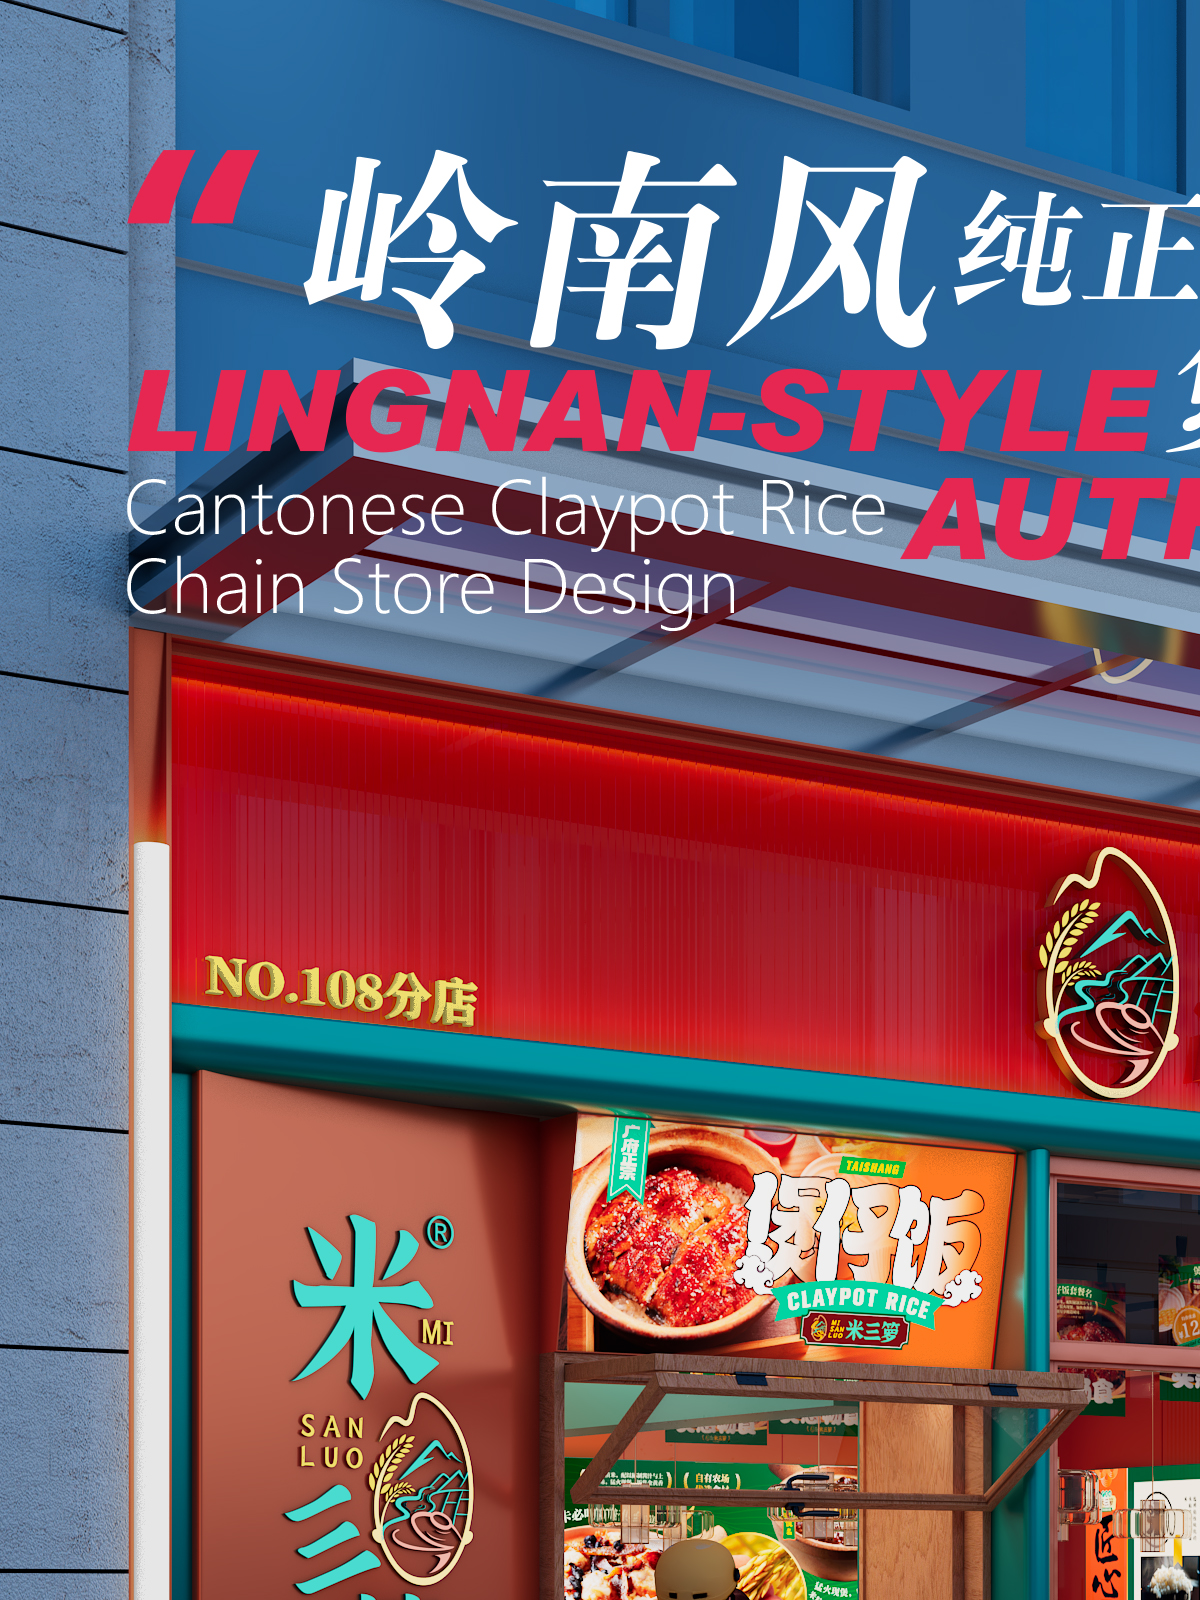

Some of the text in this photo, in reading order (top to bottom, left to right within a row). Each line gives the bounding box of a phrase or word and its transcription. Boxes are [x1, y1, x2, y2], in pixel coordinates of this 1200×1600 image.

[204, 954, 479, 1028] NO.108分店
[846, 1160, 900, 1176] TAISHANG
[745, 1170, 986, 1295] 煲仔饭
[786, 1286, 931, 1320] CLAYPOT RICE
[422, 1318, 455, 1347] MI
[845, 1318, 901, 1343] 米三箩
[300, 1413, 365, 1440] SAN
[300, 1445, 365, 1470] LUO
